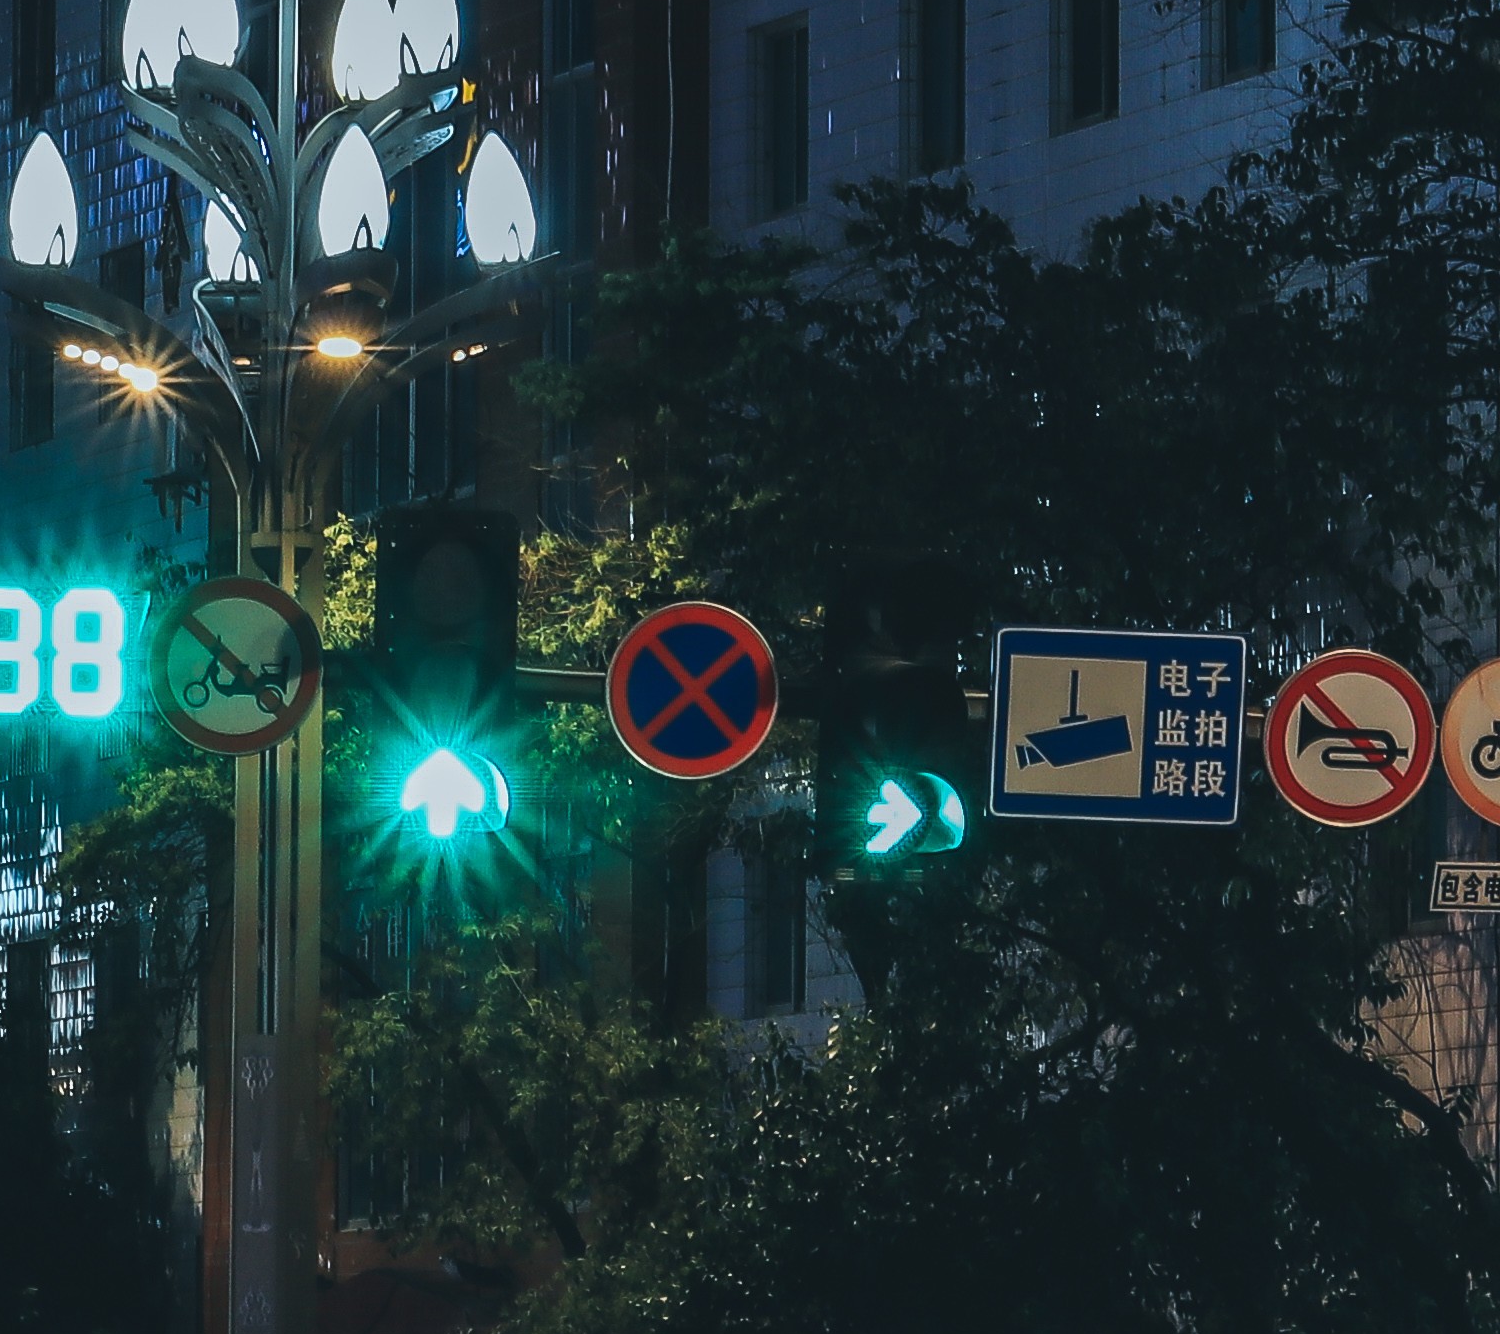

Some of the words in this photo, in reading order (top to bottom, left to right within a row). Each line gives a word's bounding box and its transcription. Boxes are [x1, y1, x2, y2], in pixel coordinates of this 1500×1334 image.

[1158, 659, 1231, 699] 电子
[1155, 709, 1229, 749] 监拍
[1152, 759, 1228, 799] 路段
